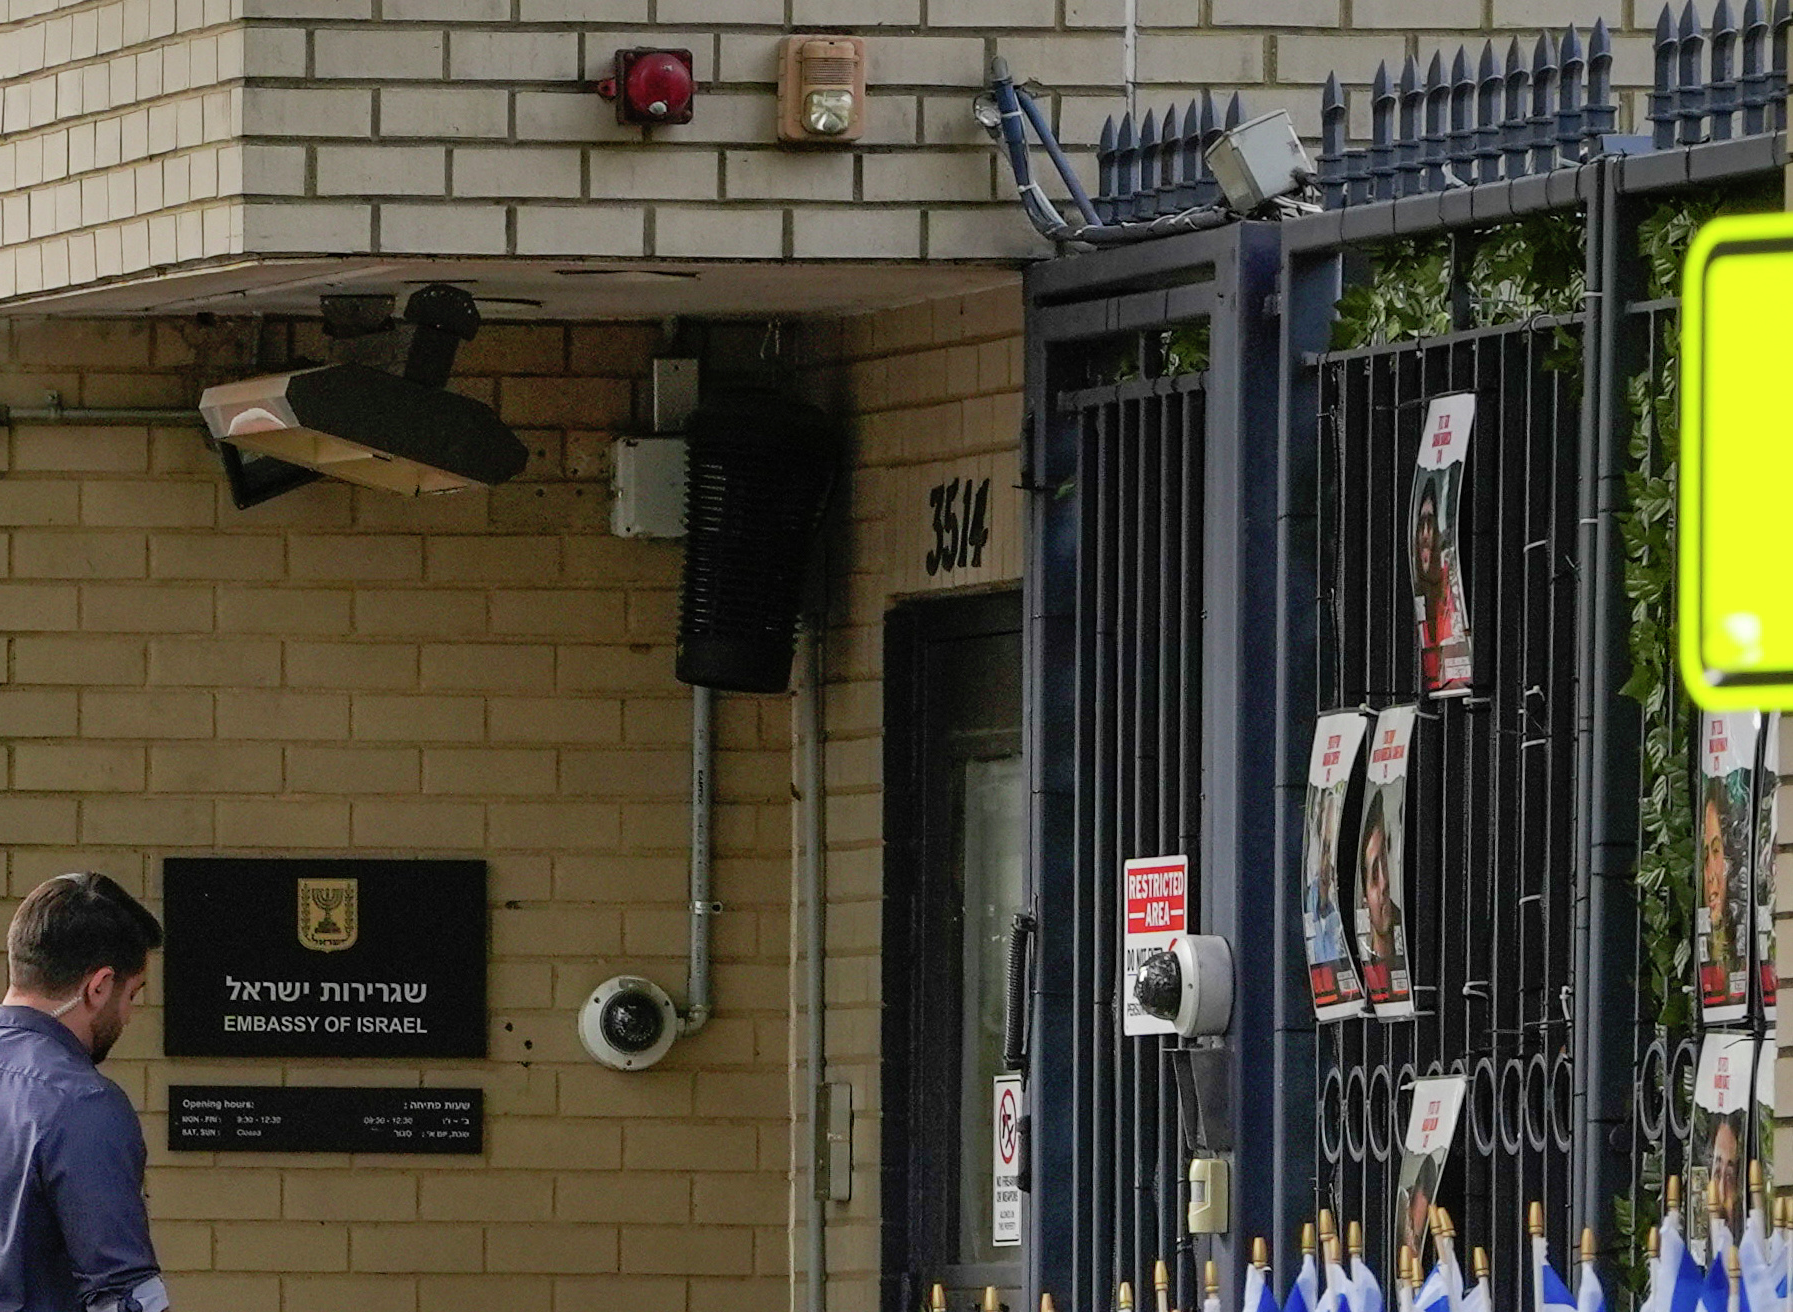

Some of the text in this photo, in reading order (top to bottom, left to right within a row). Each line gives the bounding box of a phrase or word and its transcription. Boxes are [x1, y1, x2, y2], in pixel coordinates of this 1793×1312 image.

[926, 477, 990, 576] 3514
[1128, 871, 1184, 900] RESTRICTED
[1145, 900, 1171, 927] AREA
[225, 974, 427, 1004] שגרירות ישראל
[223, 1015, 428, 1034] EMBASSY OF ISRAEL
[182, 1099, 222, 1111] Opening
